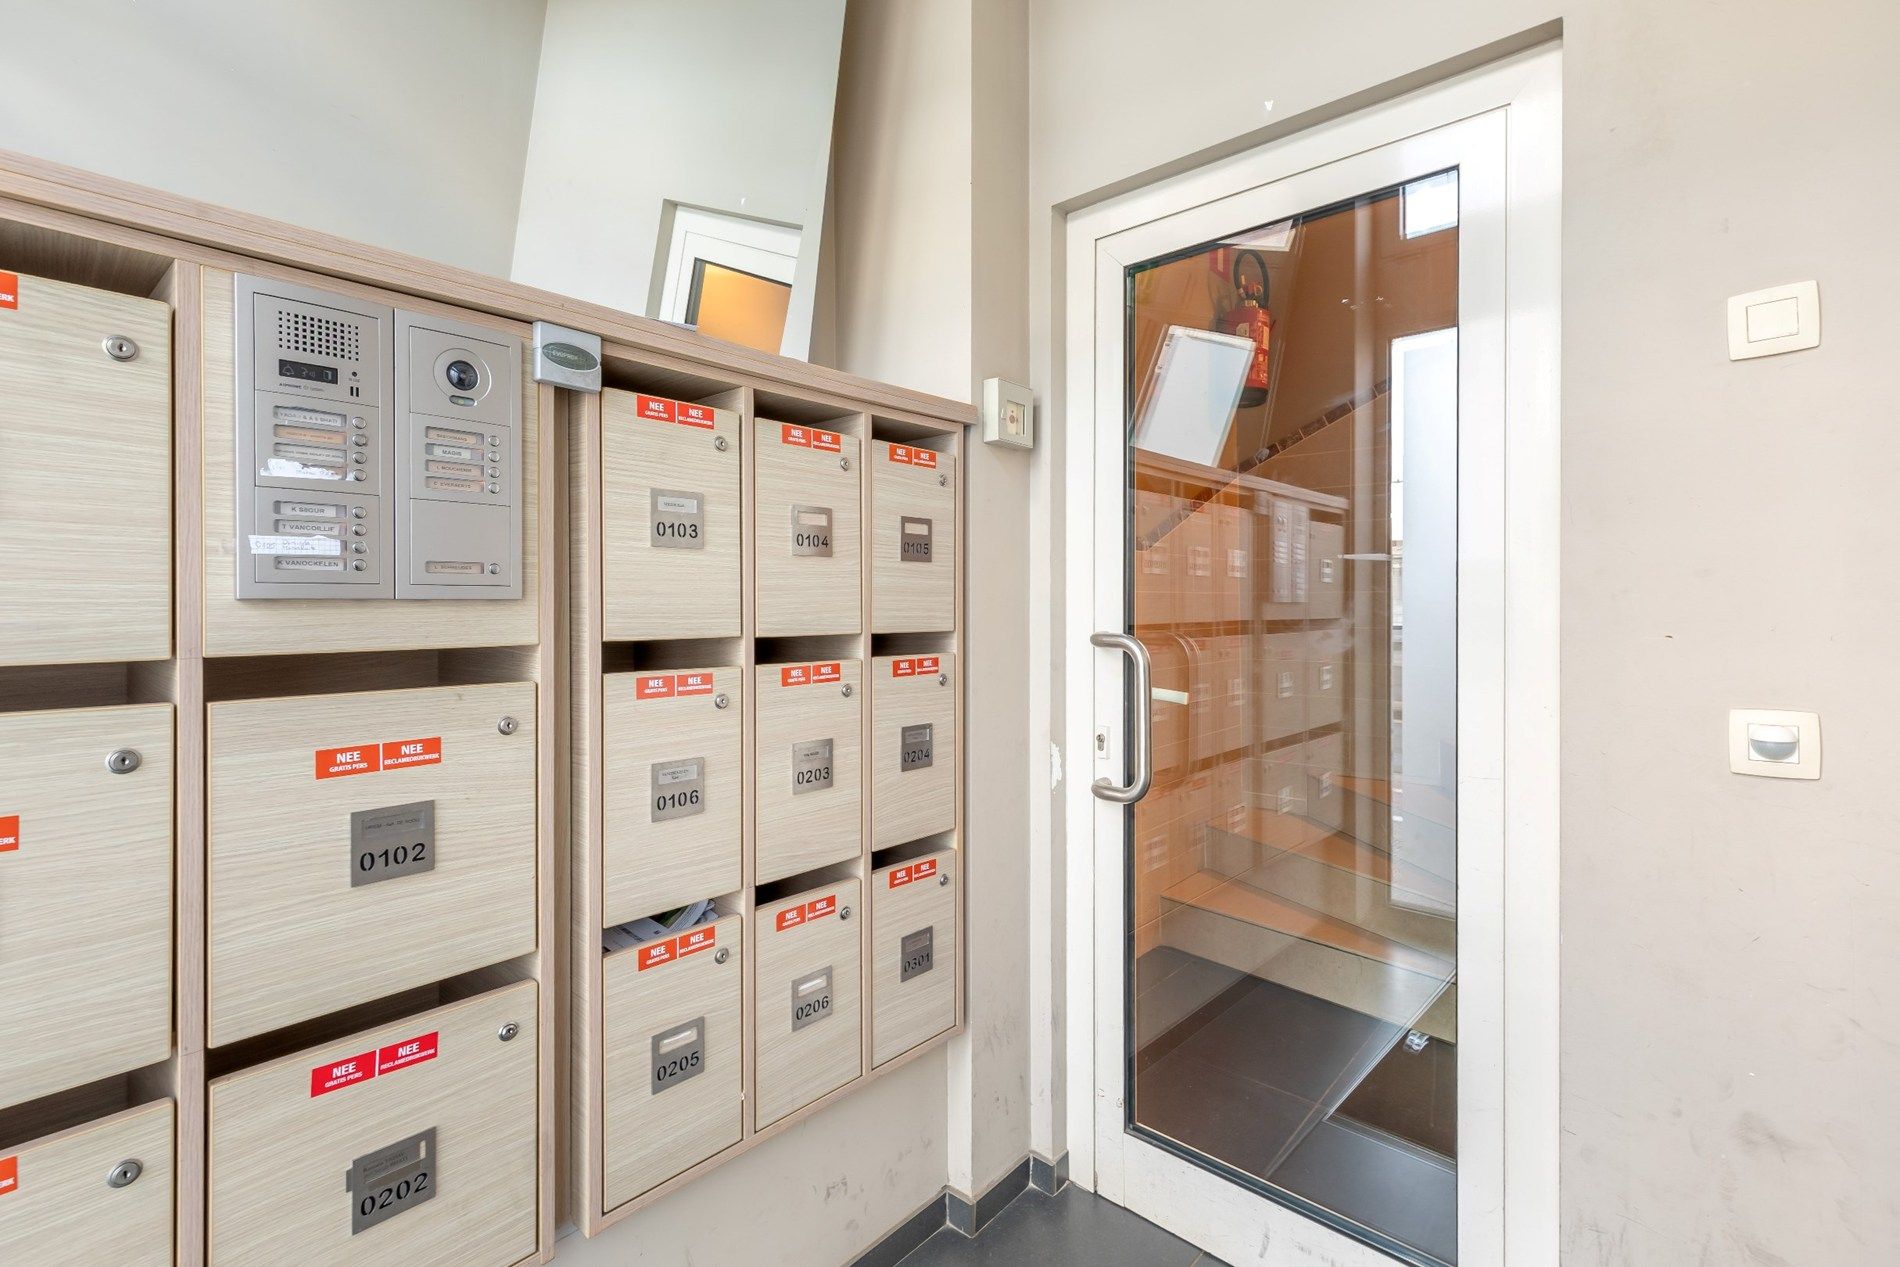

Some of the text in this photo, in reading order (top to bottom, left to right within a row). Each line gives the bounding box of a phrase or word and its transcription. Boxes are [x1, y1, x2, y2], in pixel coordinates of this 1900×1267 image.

[649, 401, 665, 411] NEE
[688, 408, 703, 418] NEE
[791, 428, 803, 437] NEE
[821, 434, 832, 443] NEE
[656, 521, 698, 538] 0103
[796, 533, 829, 548] 0104
[903, 541, 929, 555] 0105
[791, 669, 803, 677] NEE
[821, 666, 832, 674] NEE
[648, 679, 664, 688] NEE
[688, 676, 702, 685] NEE
[401, 743, 424, 755] NEE
[336, 751, 361, 763] NEE
[903, 748, 930, 763] 0204
[329, 762, 368, 773] GRATIS PERS
[797, 767, 830, 785] 0203
[656, 789, 699, 811] 0106
[360, 843, 426, 871] 0102
[815, 900, 827, 910] NEE
[785, 910, 797, 920] NEE
[690, 933, 704, 944] NEE
[650, 945, 666, 957] NEE
[904, 952, 930, 973] 0301
[796, 995, 829, 1020] 0206
[397, 1041, 420, 1057] NEE
[332, 1062, 356, 1078] NEE
[657, 1050, 699, 1081] 0205
[325, 1071, 363, 1088] GRATIS PERS
[361, 1172, 428, 1216] 0202
